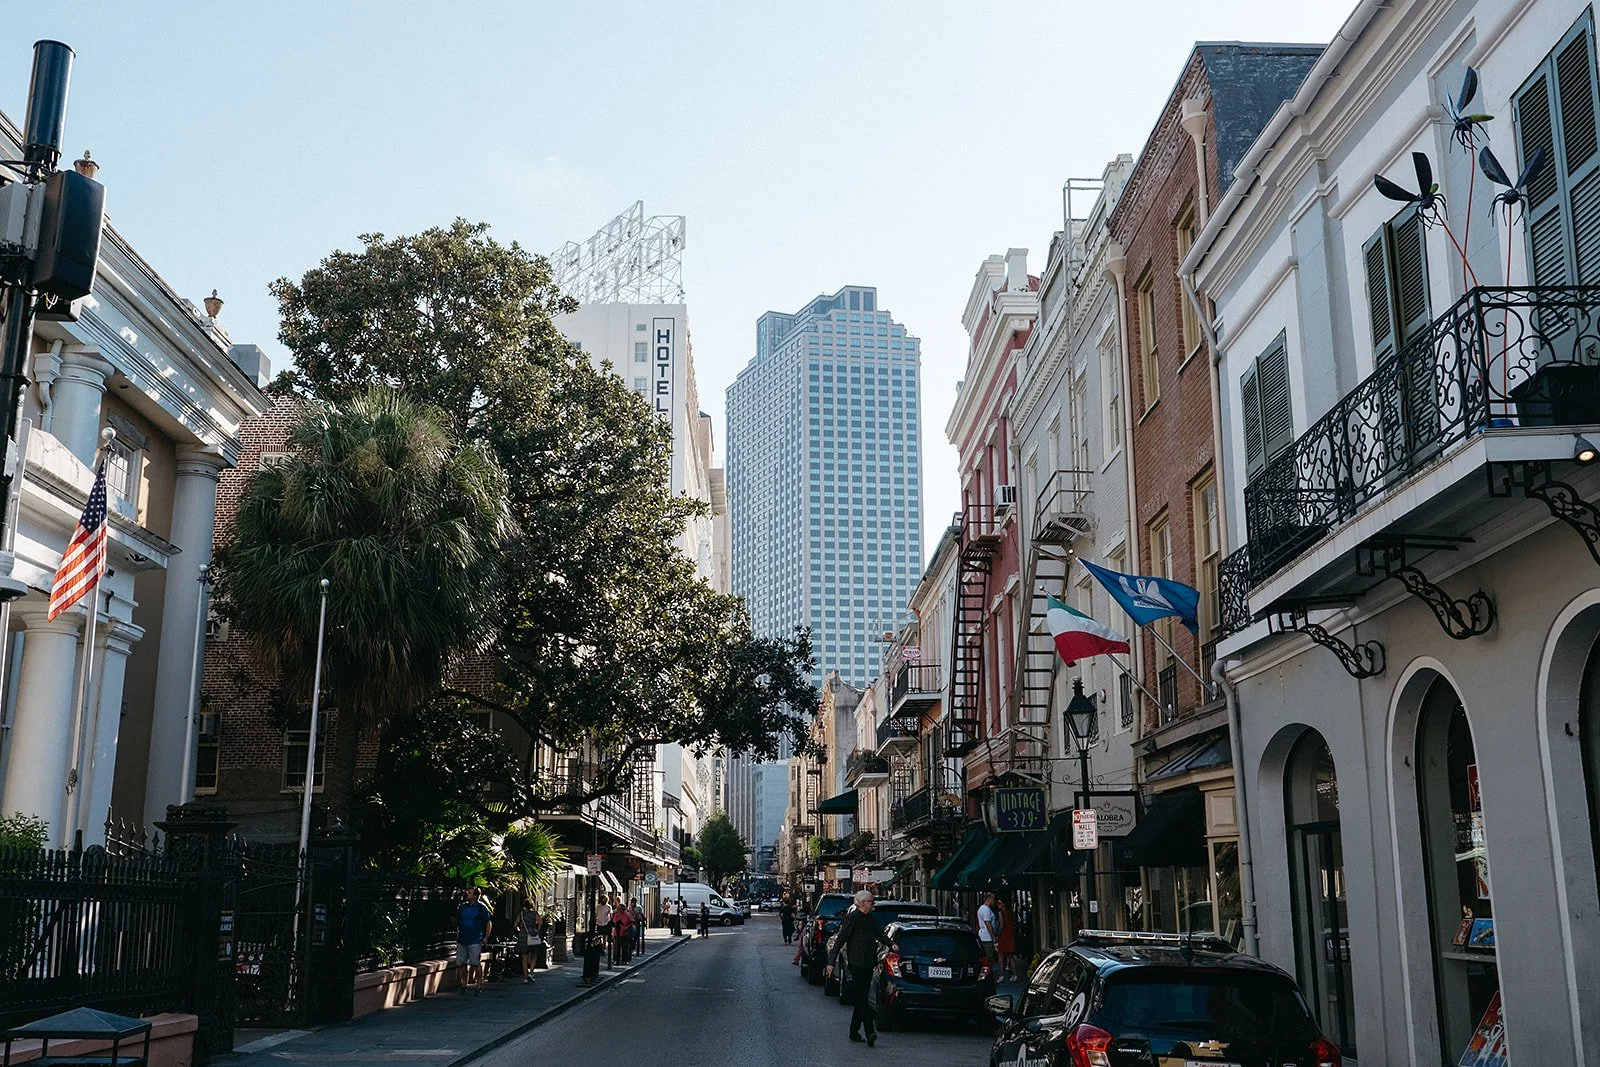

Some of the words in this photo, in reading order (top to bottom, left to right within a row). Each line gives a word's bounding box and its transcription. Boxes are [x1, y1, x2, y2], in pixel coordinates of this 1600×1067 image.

[656, 329, 670, 412] HOTEL
[1000, 792, 1041, 813] VINTAGE
[1012, 811, 1034, 827] 329
[1096, 814, 1125, 822] ALOBRA
